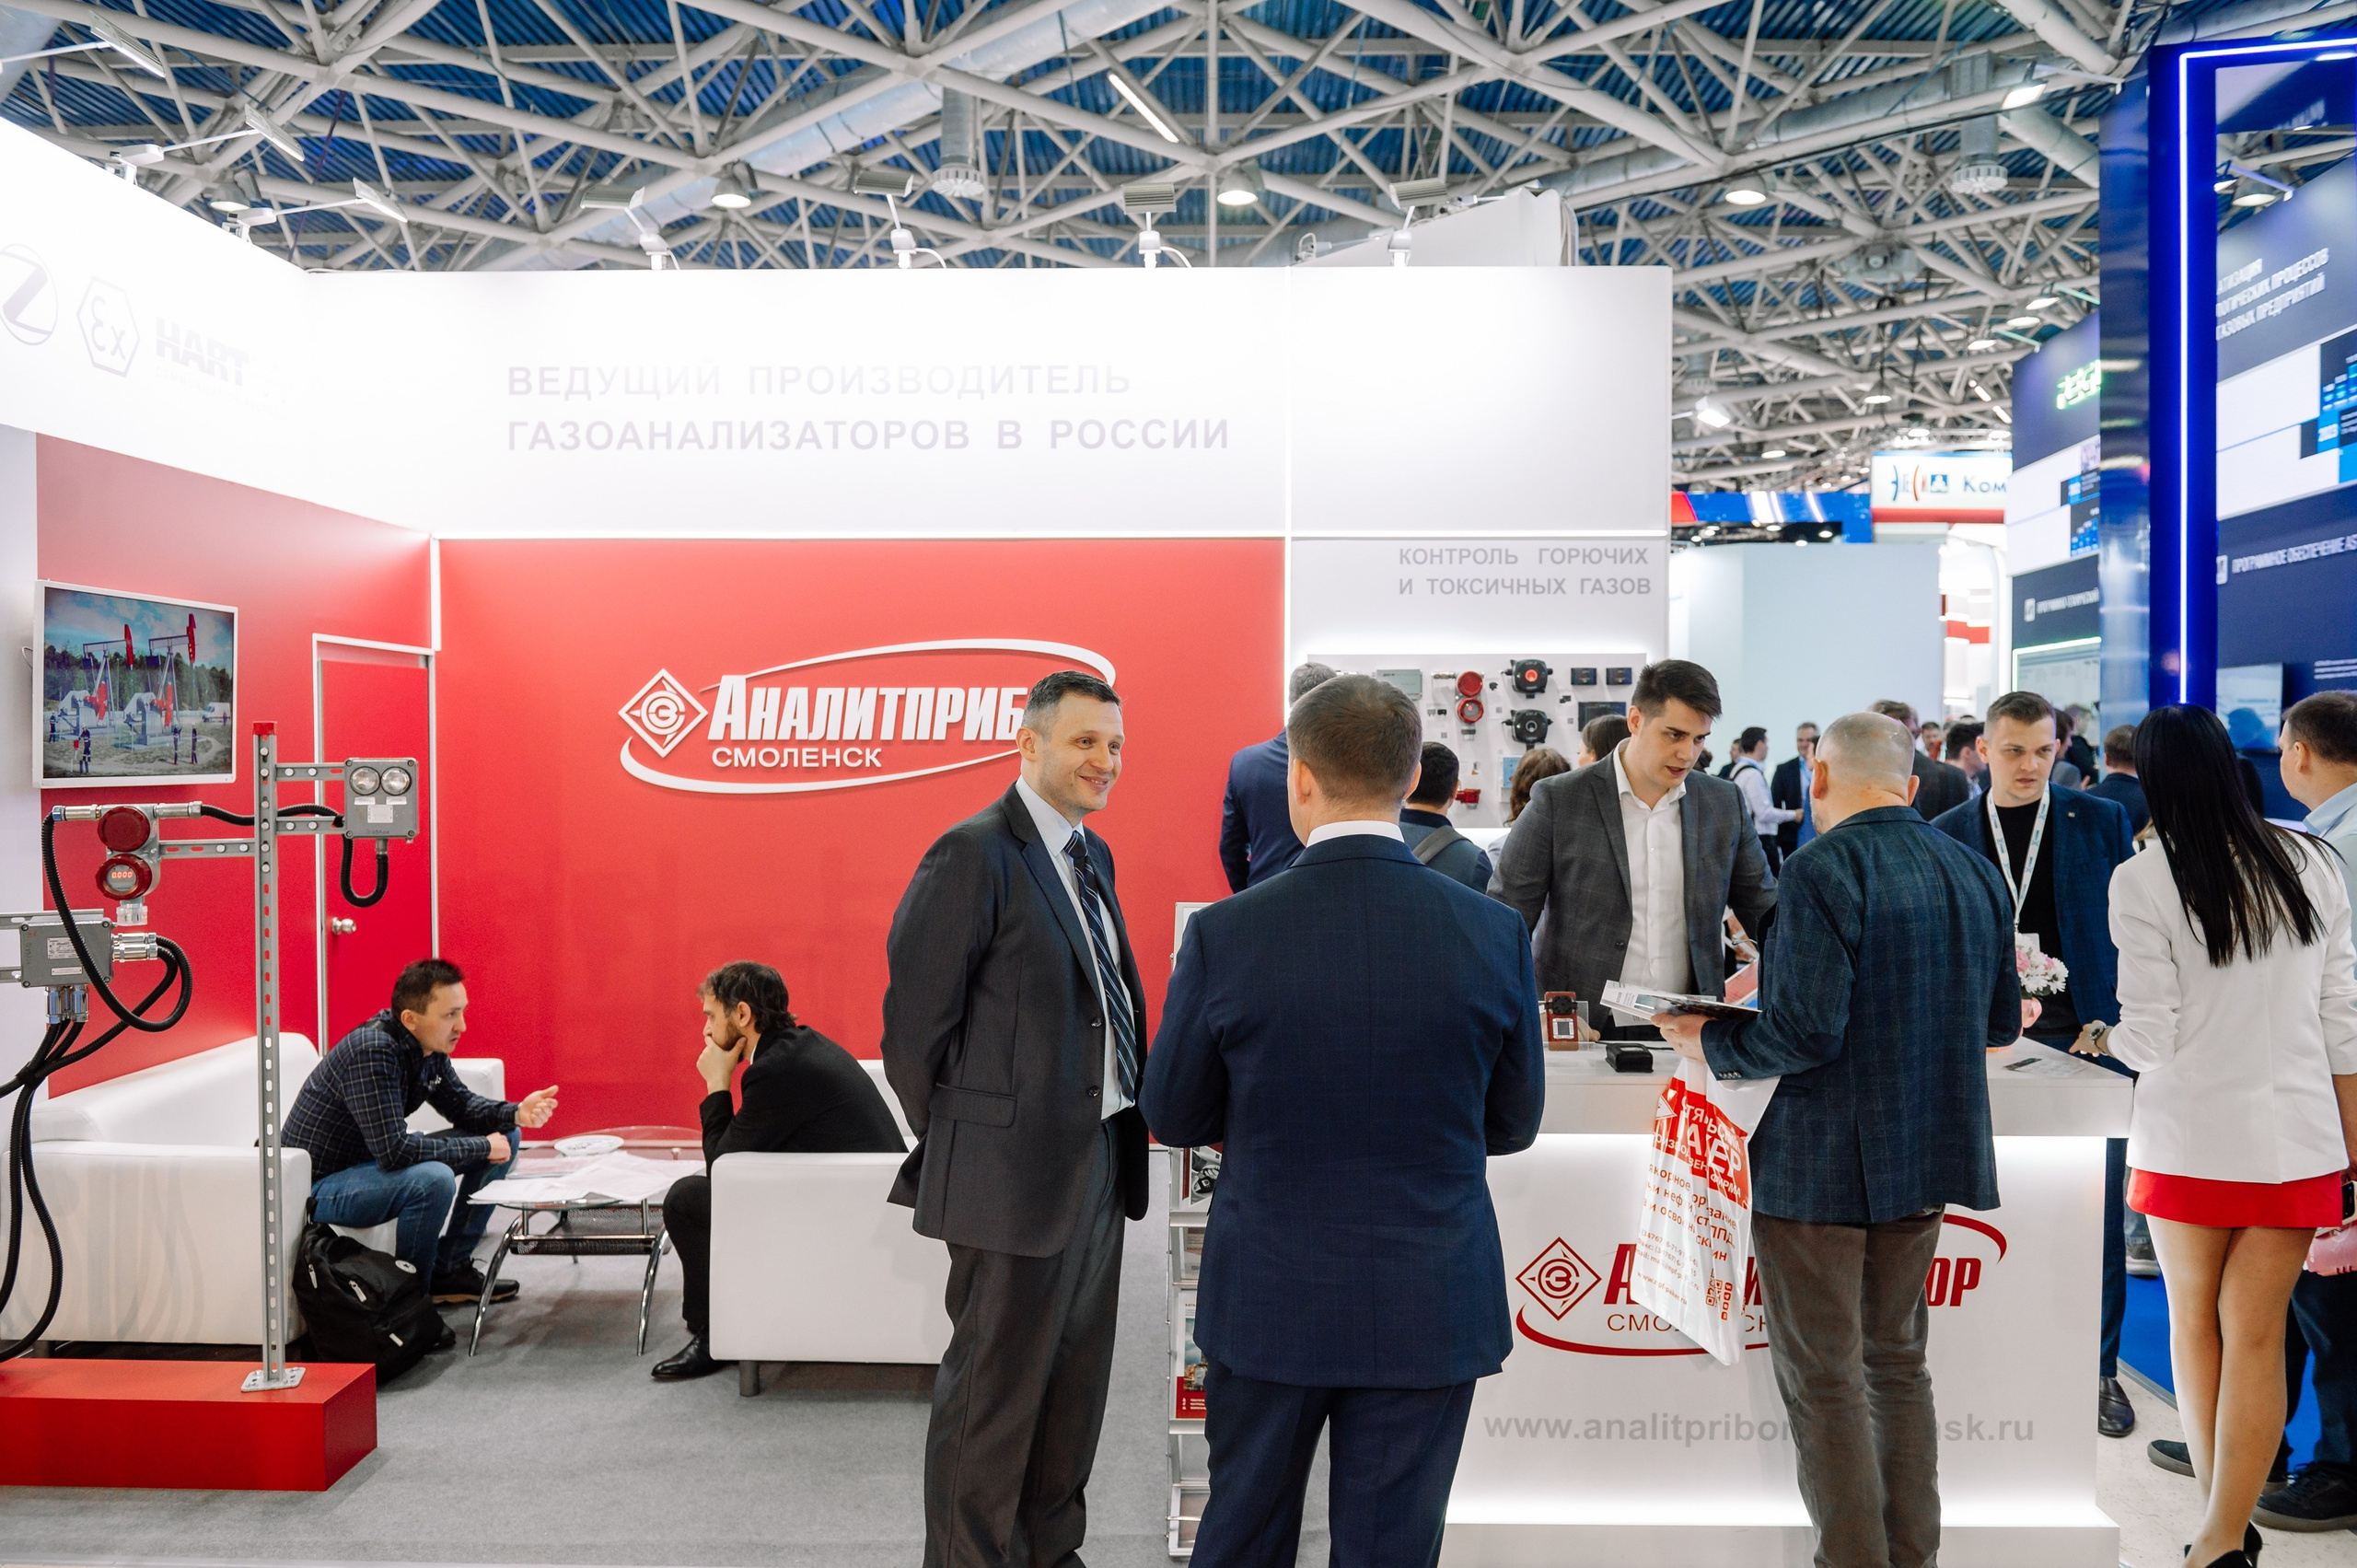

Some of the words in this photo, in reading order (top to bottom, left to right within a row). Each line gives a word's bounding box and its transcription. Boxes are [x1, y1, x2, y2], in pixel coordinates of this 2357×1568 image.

[156, 316, 250, 387] HART
[507, 358, 721, 401] ВЕДУЩИЙ
[749, 365, 1131, 400] ПРОИЗВОДИТЕЛЬ
[507, 419, 970, 450] ГАЗОАНАЛИЗАТОРОВ
[996, 420, 1023, 449] В
[1050, 418, 1228, 449] РОССИИ
[1399, 547, 1519, 565] КОНТРОЛЬ
[1538, 547, 1649, 565] ГОРЮЧИХ
[1399, 578, 1413, 596] И
[1426, 578, 1567, 596] ТОКСИЧНЫХ
[1579, 577, 1651, 596] ГАЗОВ
[708, 675, 1028, 740] АНАЛИТПРИБ
[712, 747, 882, 768] СМОЛЕНСК
